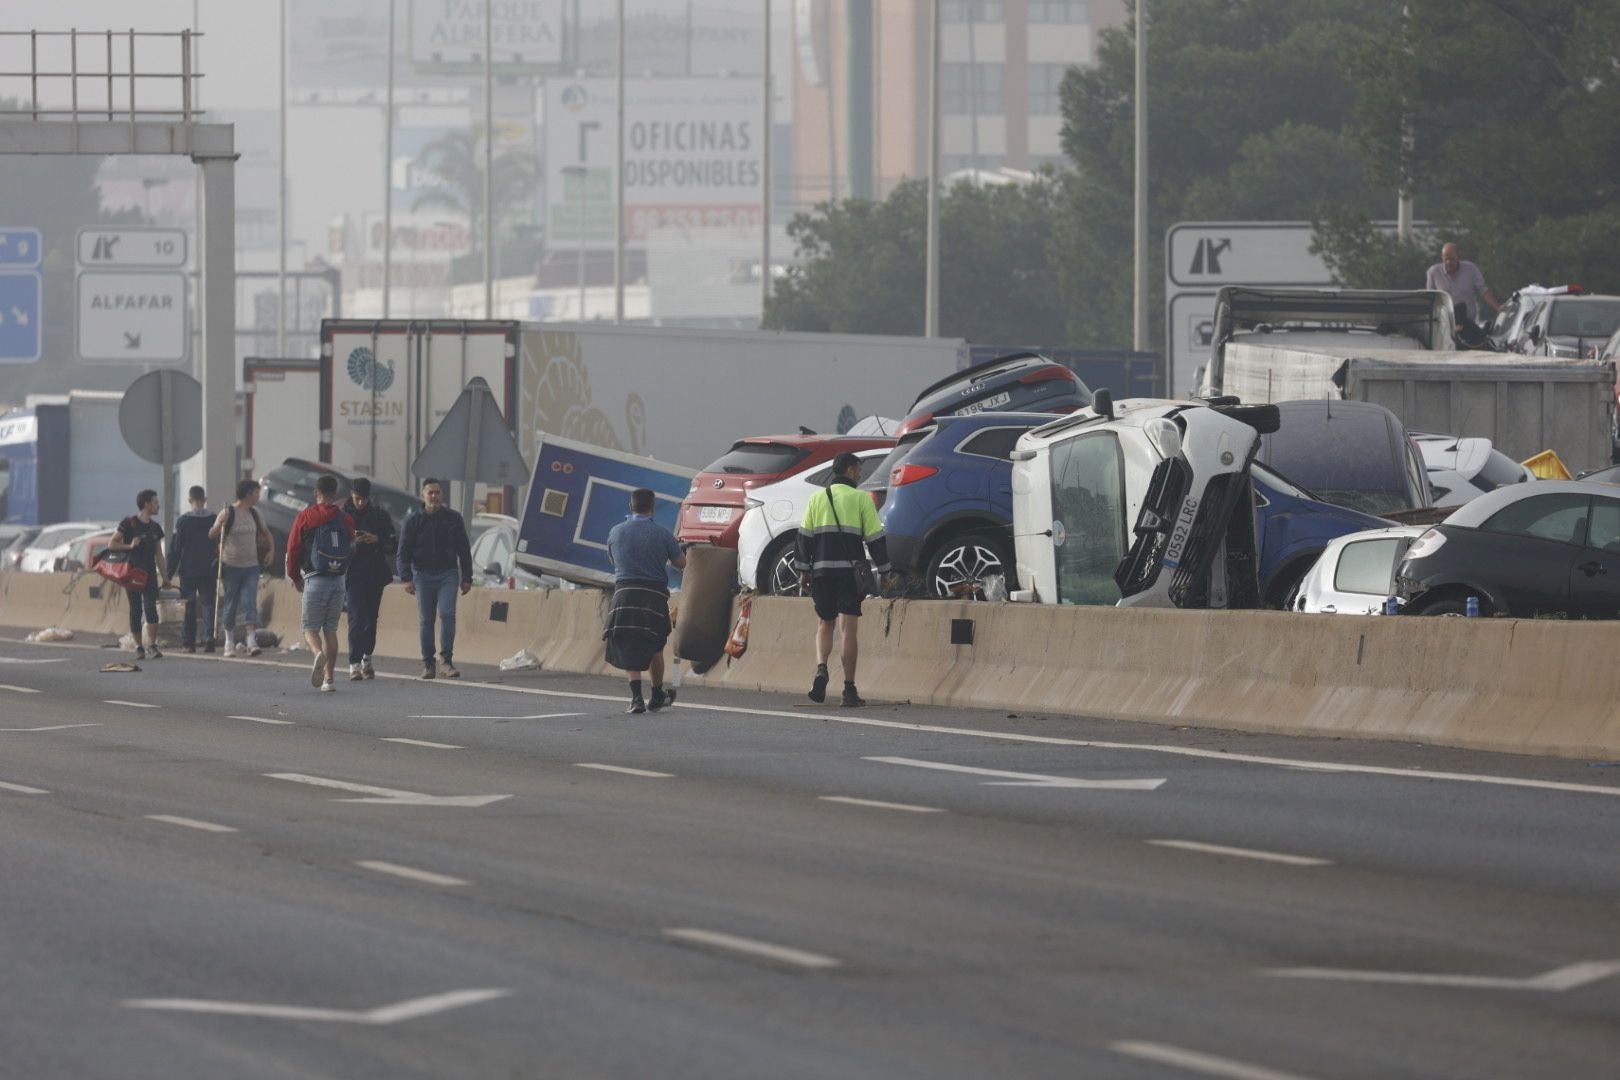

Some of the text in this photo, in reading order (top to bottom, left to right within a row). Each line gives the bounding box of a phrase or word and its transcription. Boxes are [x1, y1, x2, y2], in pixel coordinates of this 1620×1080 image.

[629, 120, 752, 151] OFICINAS
[624, 159, 761, 188] DISPONIBLES
[154, 241, 174, 255] 10
[91, 294, 173, 310] ALFAFAR
[339, 400, 404, 417] STASIN
[1168, 498, 1198, 559] 0592 LRC
